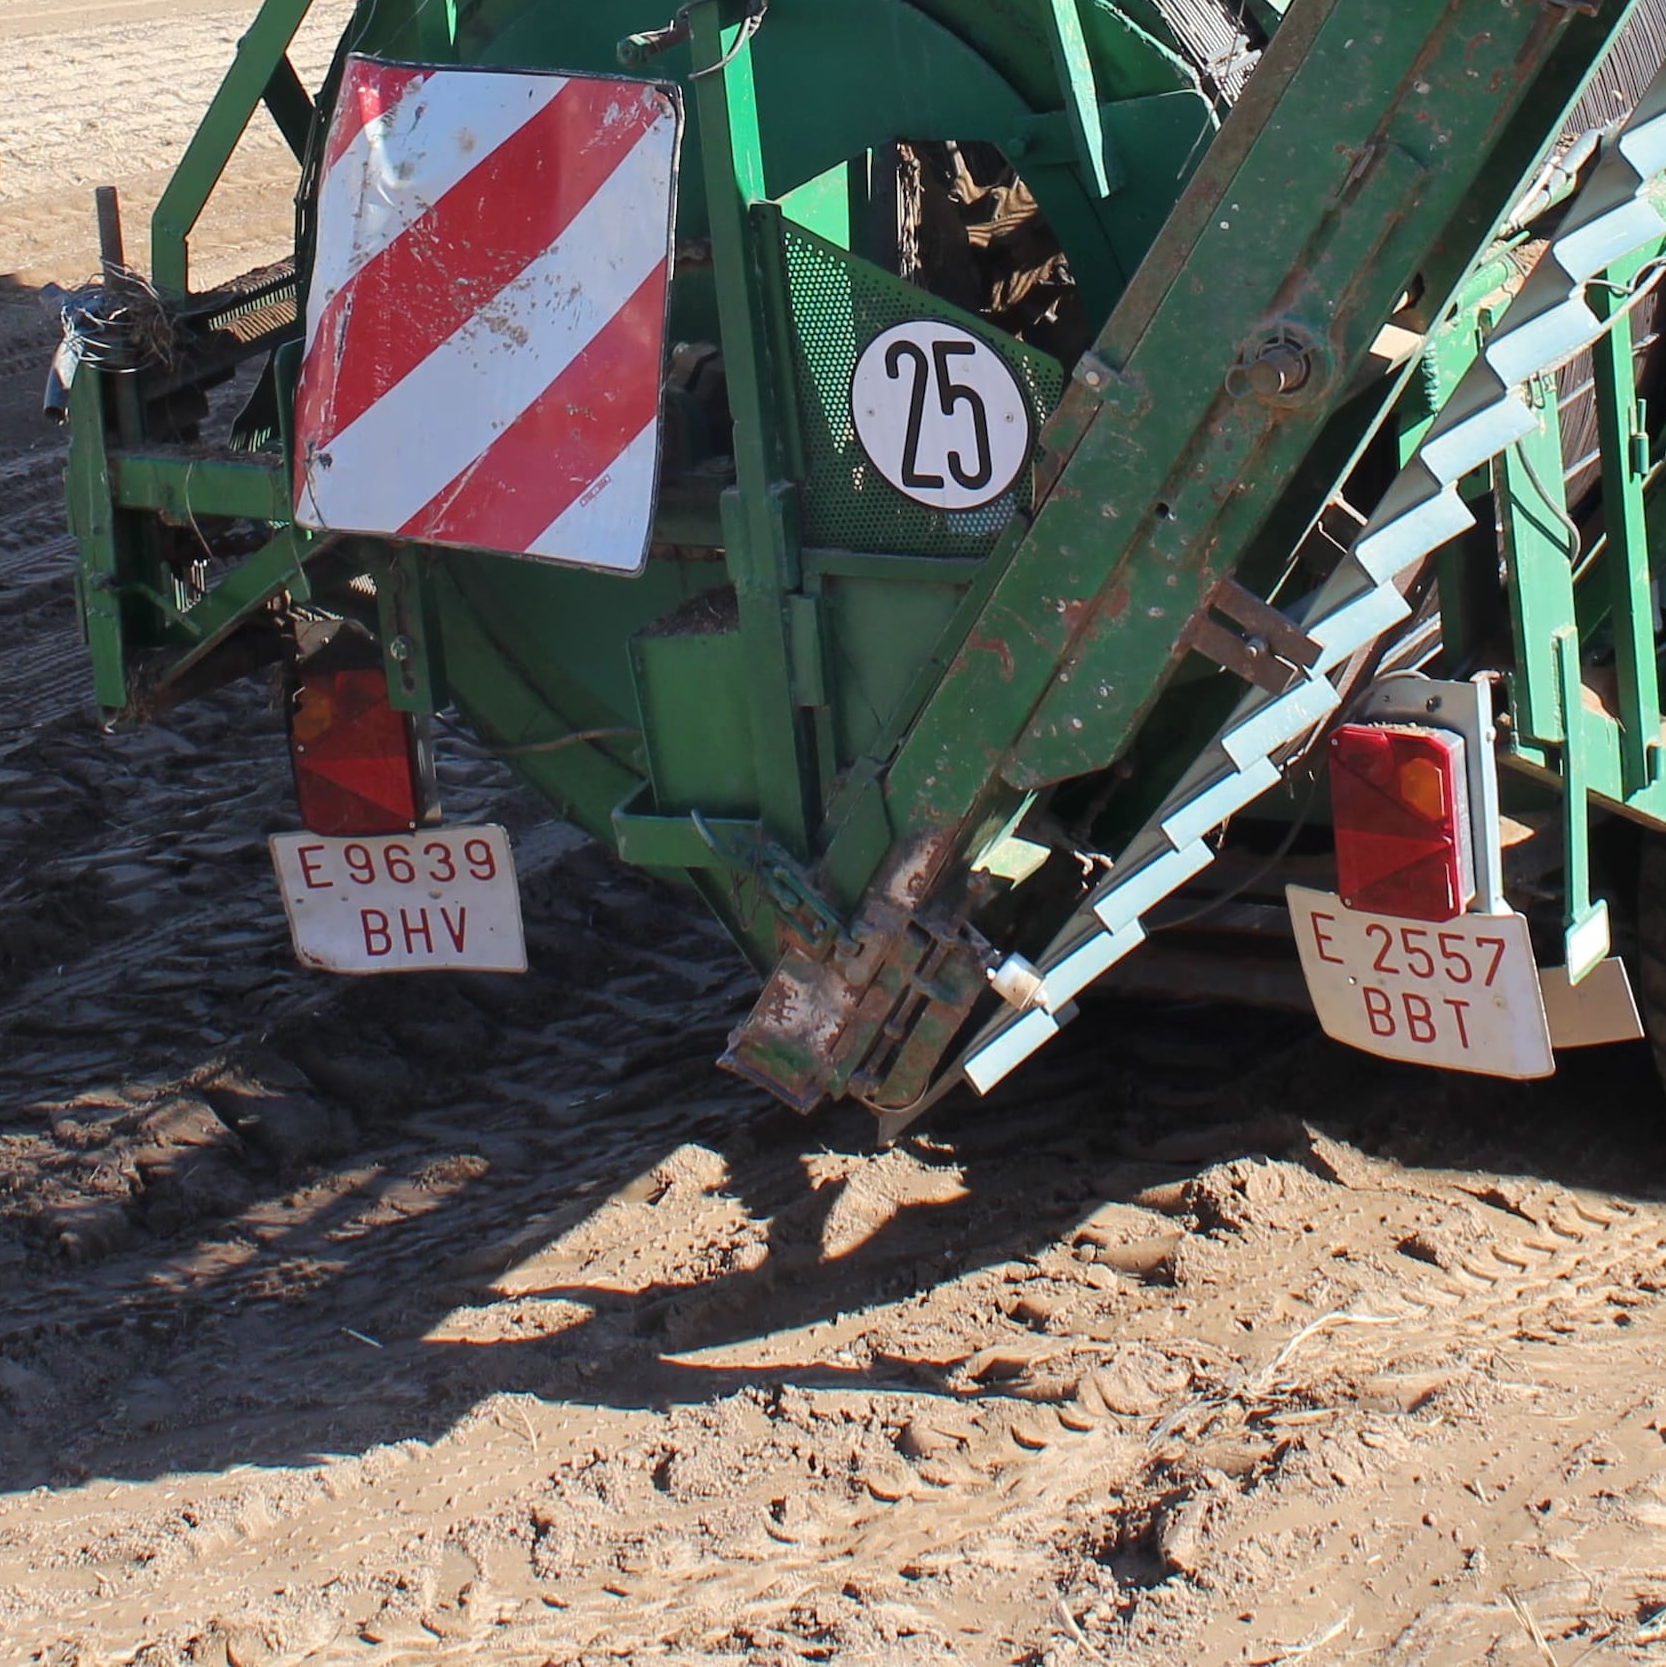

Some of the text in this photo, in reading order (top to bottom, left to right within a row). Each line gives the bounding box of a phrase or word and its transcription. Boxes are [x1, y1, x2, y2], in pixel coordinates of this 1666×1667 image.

[884, 339, 993, 491] 25
[360, 906, 467, 957] BHV
[1362, 985, 1470, 1050] BBT
